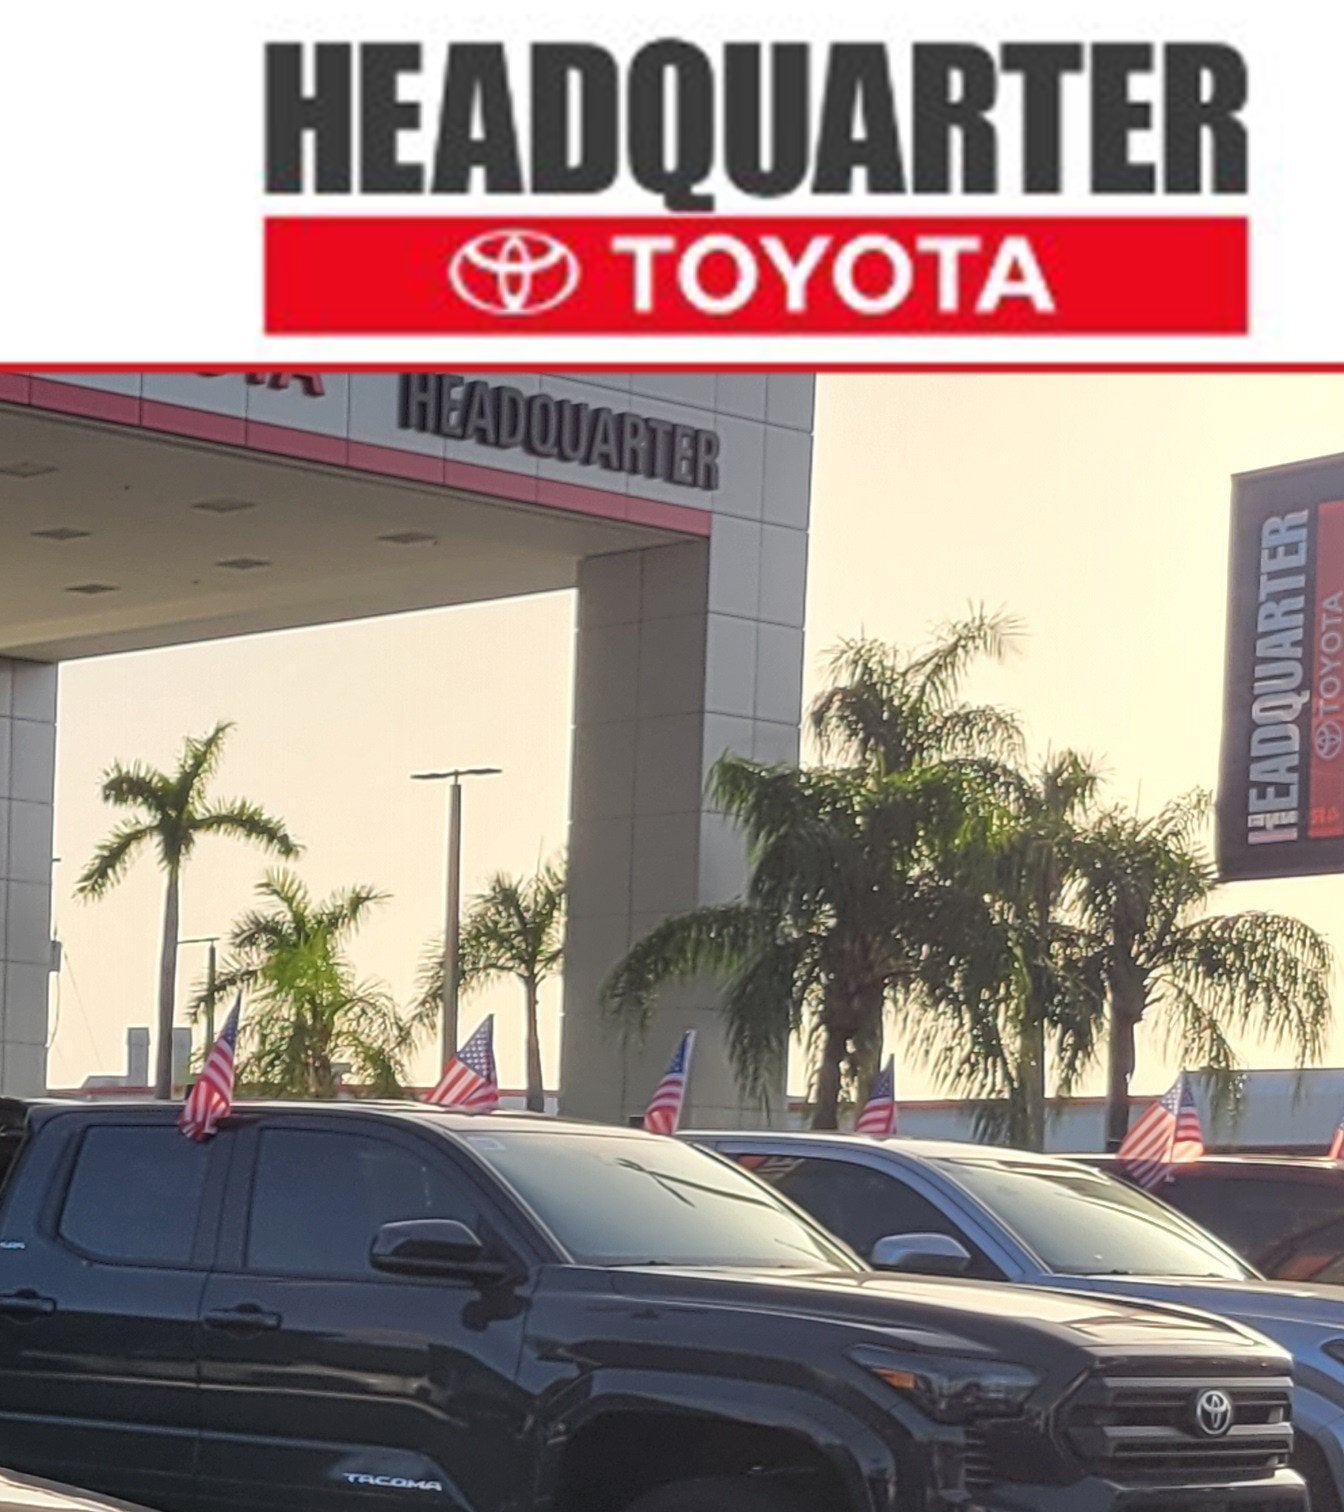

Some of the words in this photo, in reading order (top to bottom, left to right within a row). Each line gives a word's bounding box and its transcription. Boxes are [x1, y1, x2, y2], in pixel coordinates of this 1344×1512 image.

[398, 373, 720, 490] HEADQUARTER
[1247, 508, 1310, 845] HEADQUARTER
[1319, 591, 1344, 717] TOYOTA
[342, 1472, 443, 1492] TACOMA
